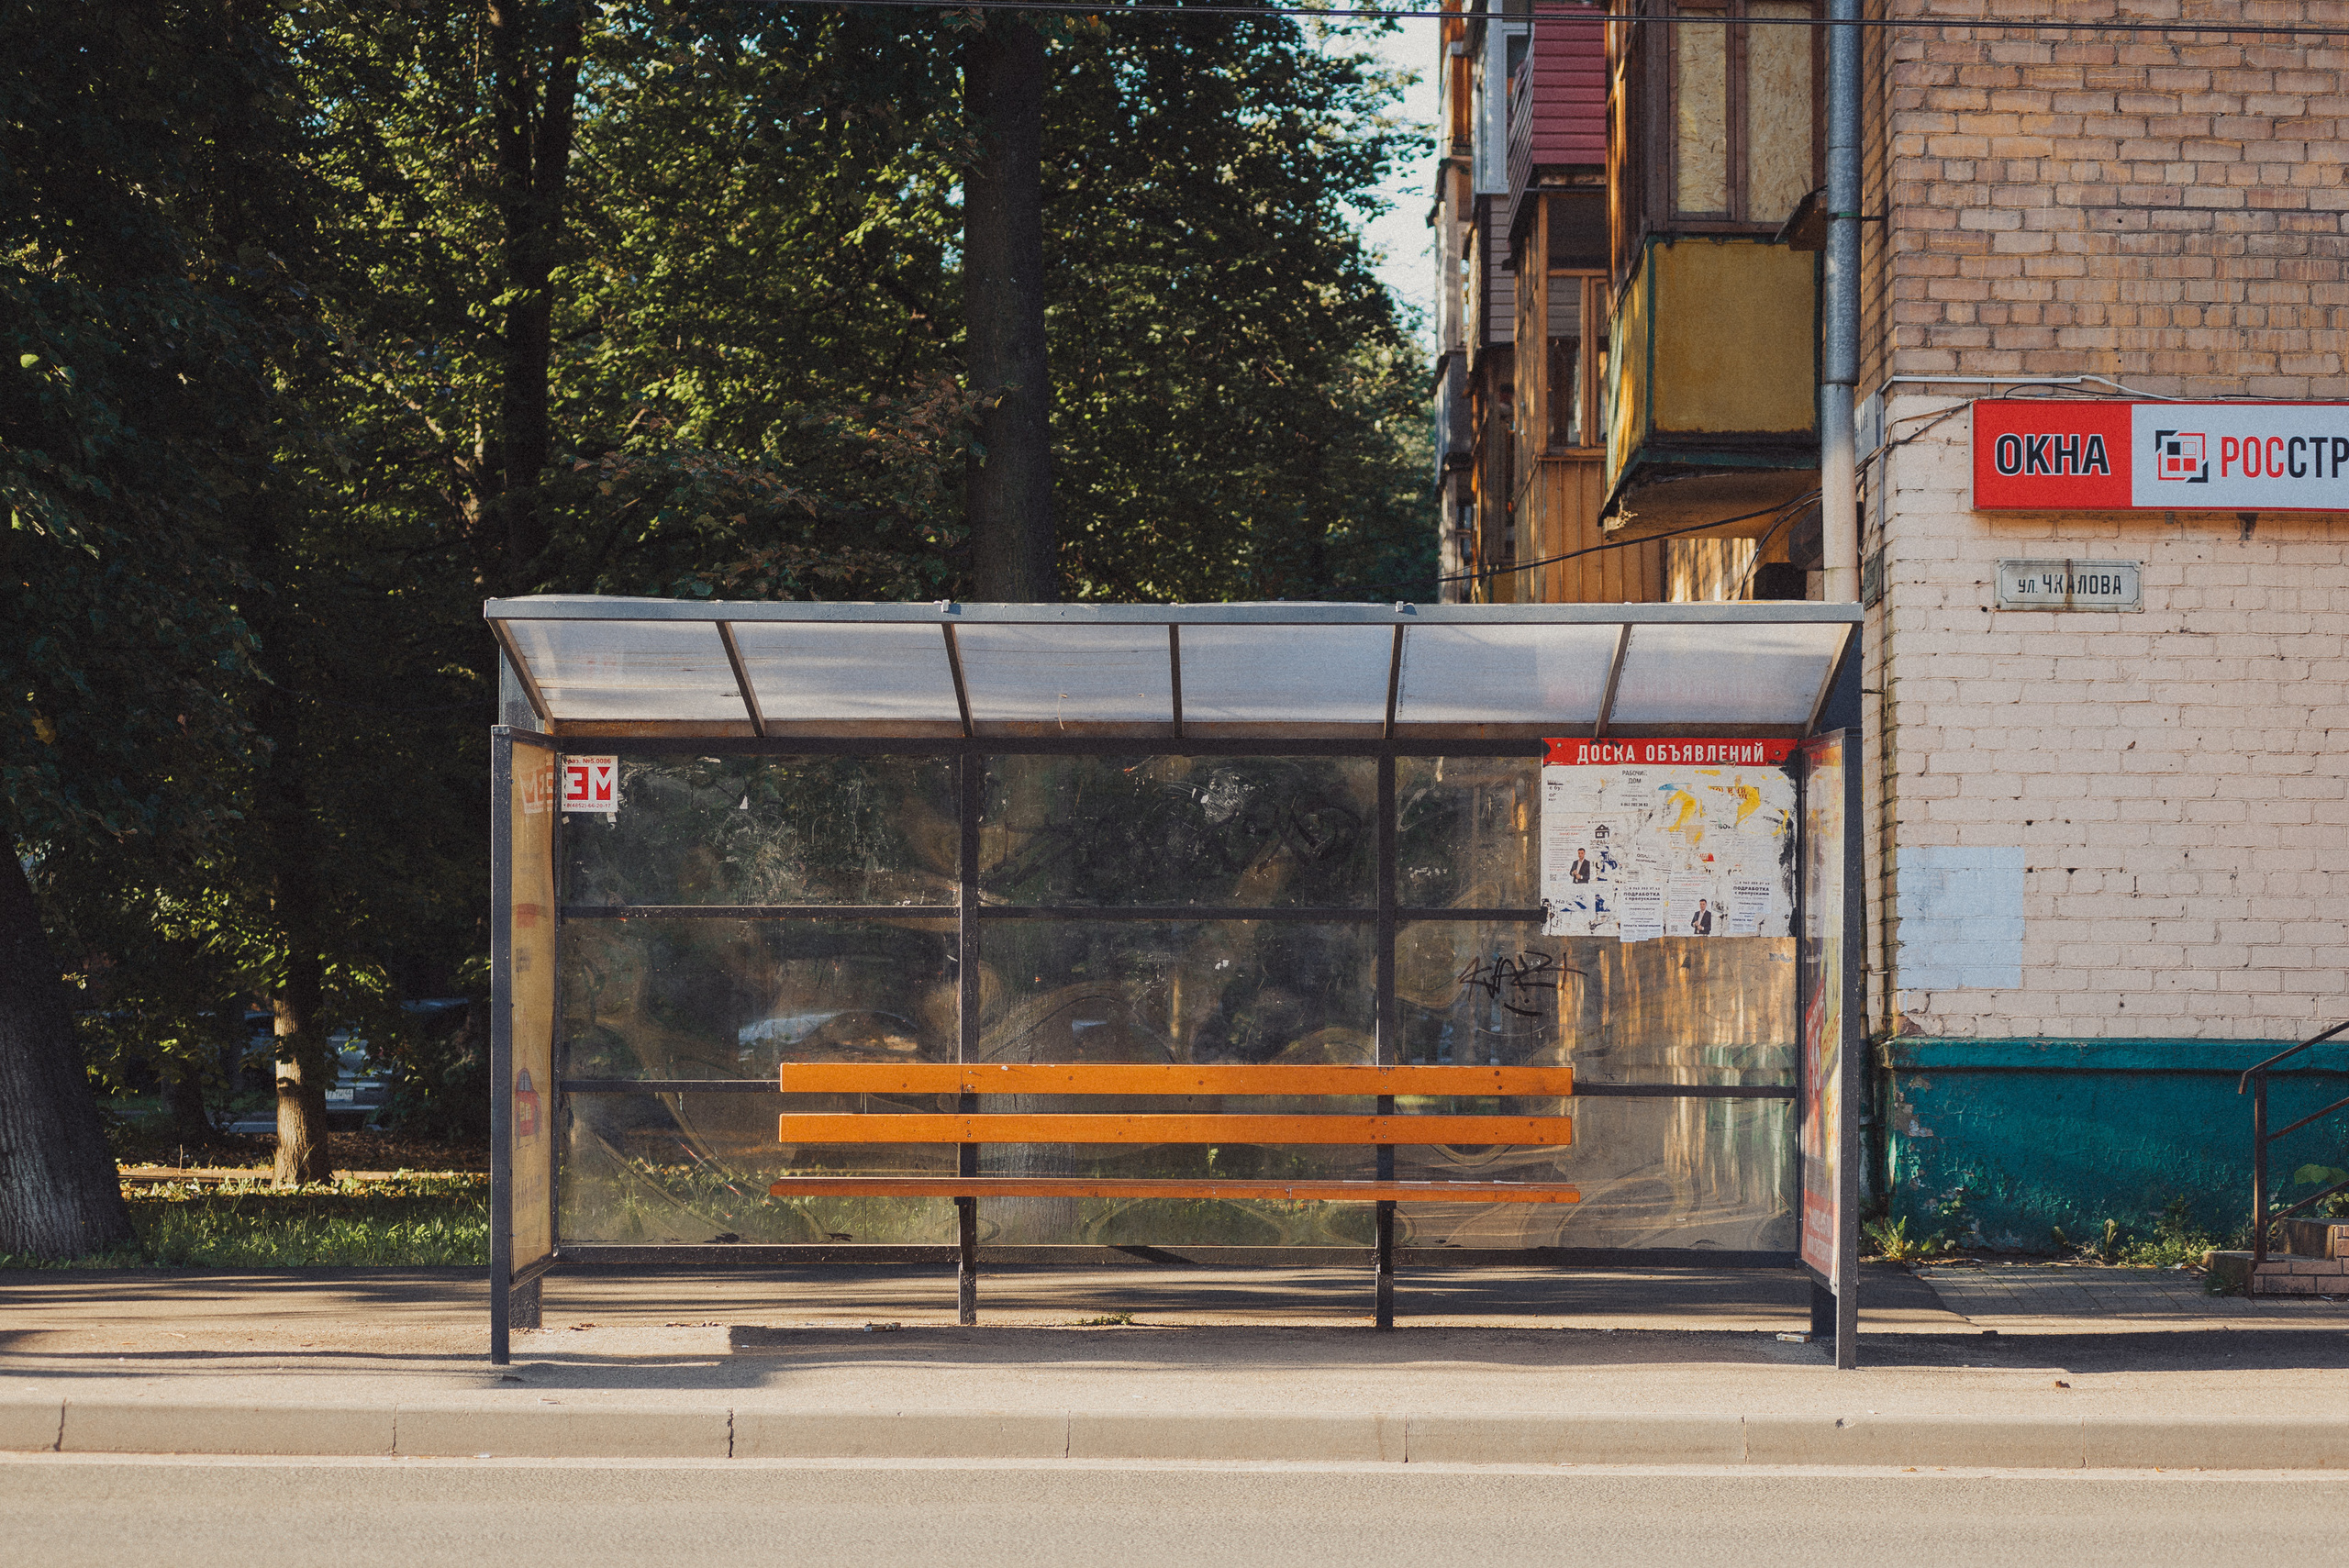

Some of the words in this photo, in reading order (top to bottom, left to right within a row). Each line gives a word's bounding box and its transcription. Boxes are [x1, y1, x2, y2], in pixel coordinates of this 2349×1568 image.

[1995, 433, 2110, 476] ОКНА
[2018, 579, 2038, 594] ул.
[2043, 574, 2121, 595] ЧКАЛОВА
[1576, 744, 1635, 764] ДОСКА
[1646, 742, 1764, 762] ОБЪЯВЛЕНИЙ
[567, 766, 611, 800] ЭМ
